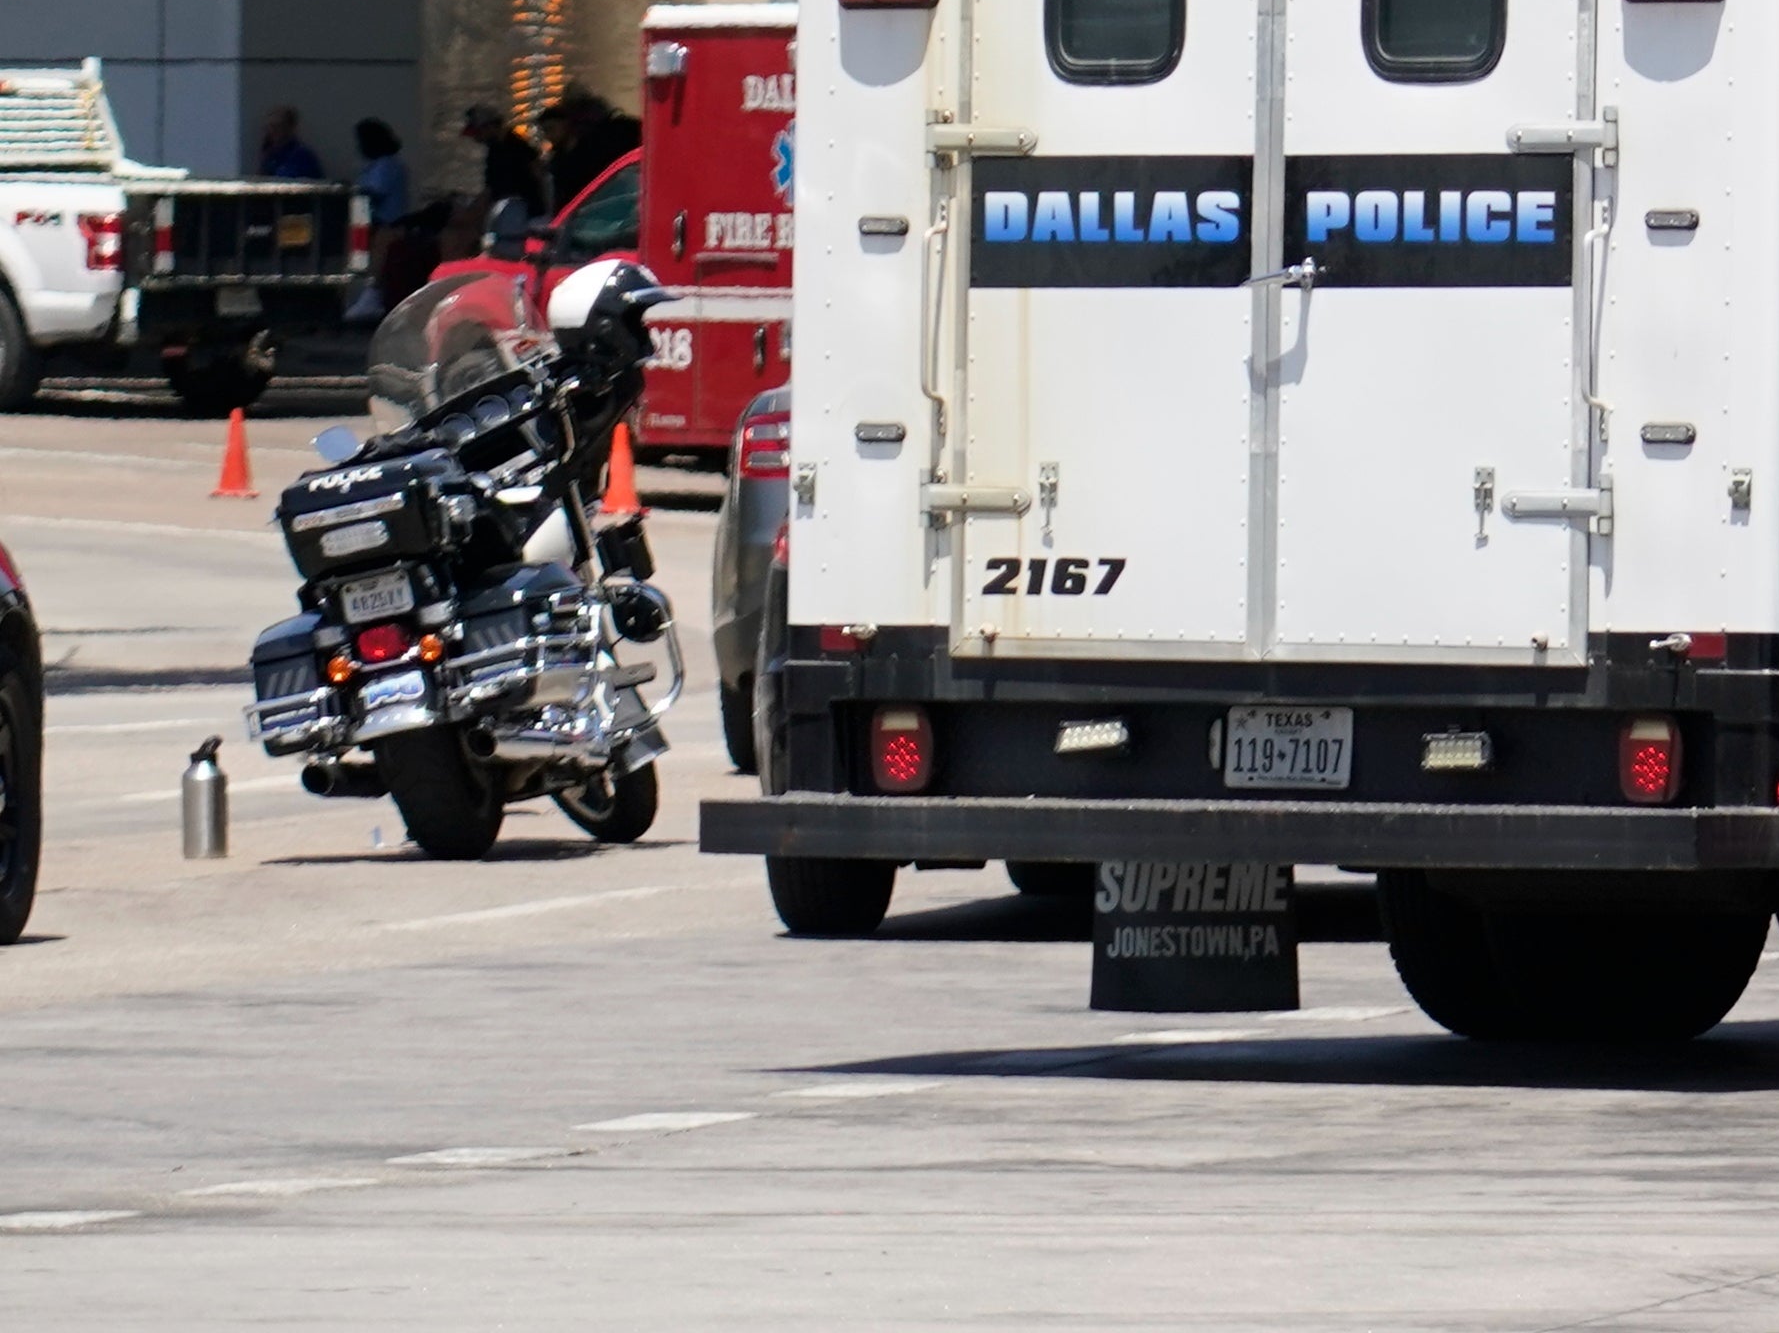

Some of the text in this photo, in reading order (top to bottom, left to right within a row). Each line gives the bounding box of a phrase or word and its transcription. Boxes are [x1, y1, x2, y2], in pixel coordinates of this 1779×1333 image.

[740, 73, 796, 113] DAL
[704, 212, 773, 250] FIRE
[984, 190, 1557, 243] DALLAS POLICE
[982, 558, 1126, 596] 2167
[1265, 711, 1313, 728] TEXAS
[1095, 860, 1293, 914] SUPREME
[1106, 924, 1280, 961] JONESTOWN,PA
